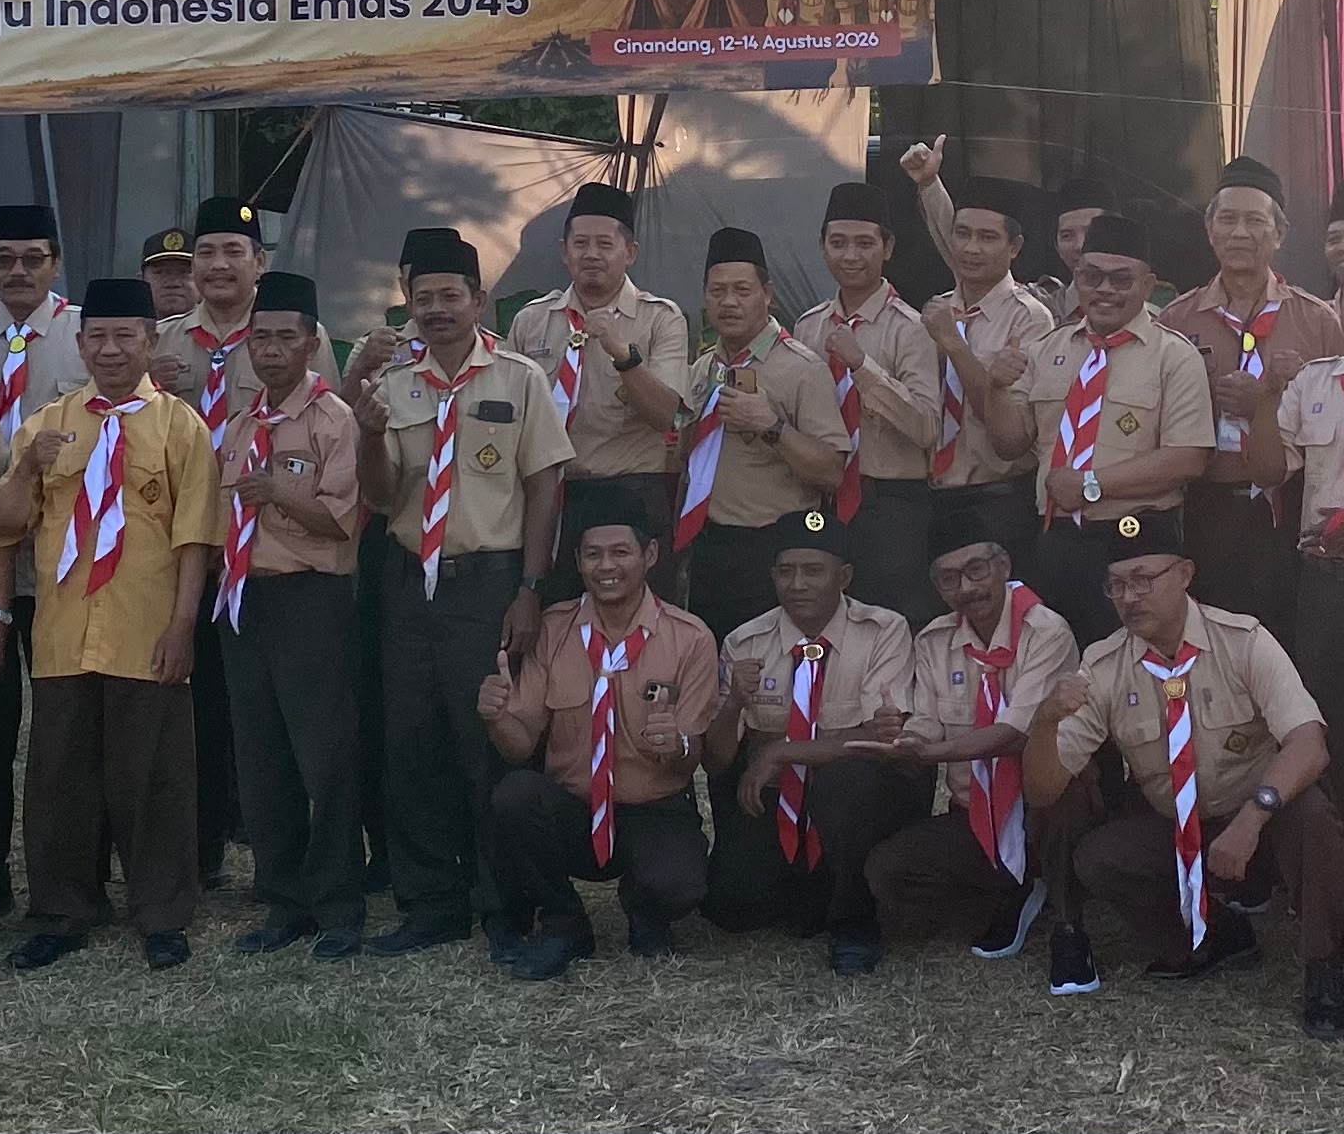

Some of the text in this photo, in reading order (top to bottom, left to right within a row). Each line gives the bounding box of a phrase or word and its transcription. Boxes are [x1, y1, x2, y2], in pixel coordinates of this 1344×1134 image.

[613, 31, 880, 55] Cinandang, 12-14 Agustus 2026
